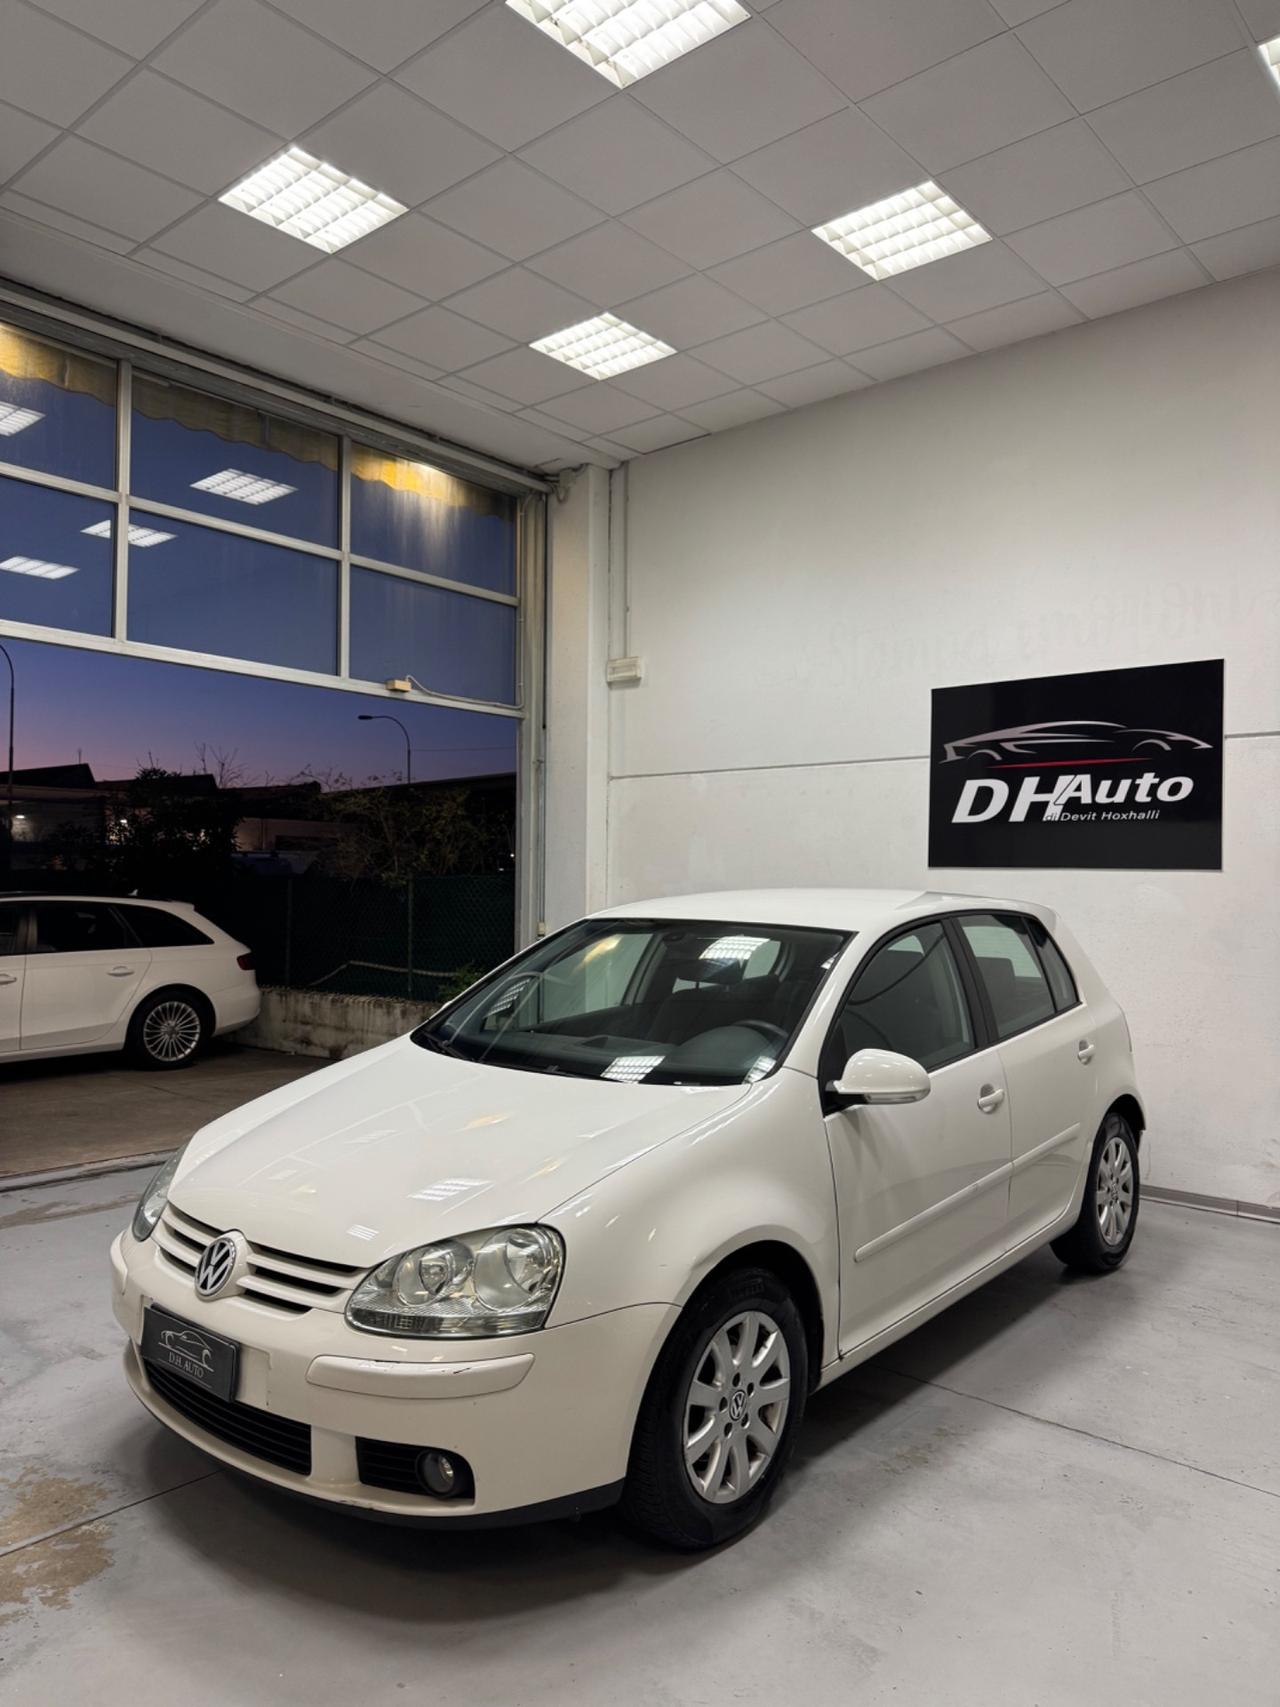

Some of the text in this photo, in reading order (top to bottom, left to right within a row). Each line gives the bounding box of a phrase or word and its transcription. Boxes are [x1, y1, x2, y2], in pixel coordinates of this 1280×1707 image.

[1060, 811, 1097, 821] Devit
[1101, 809, 1160, 820] Hoxhalli
[183, 1360, 204, 1378] AUTO
